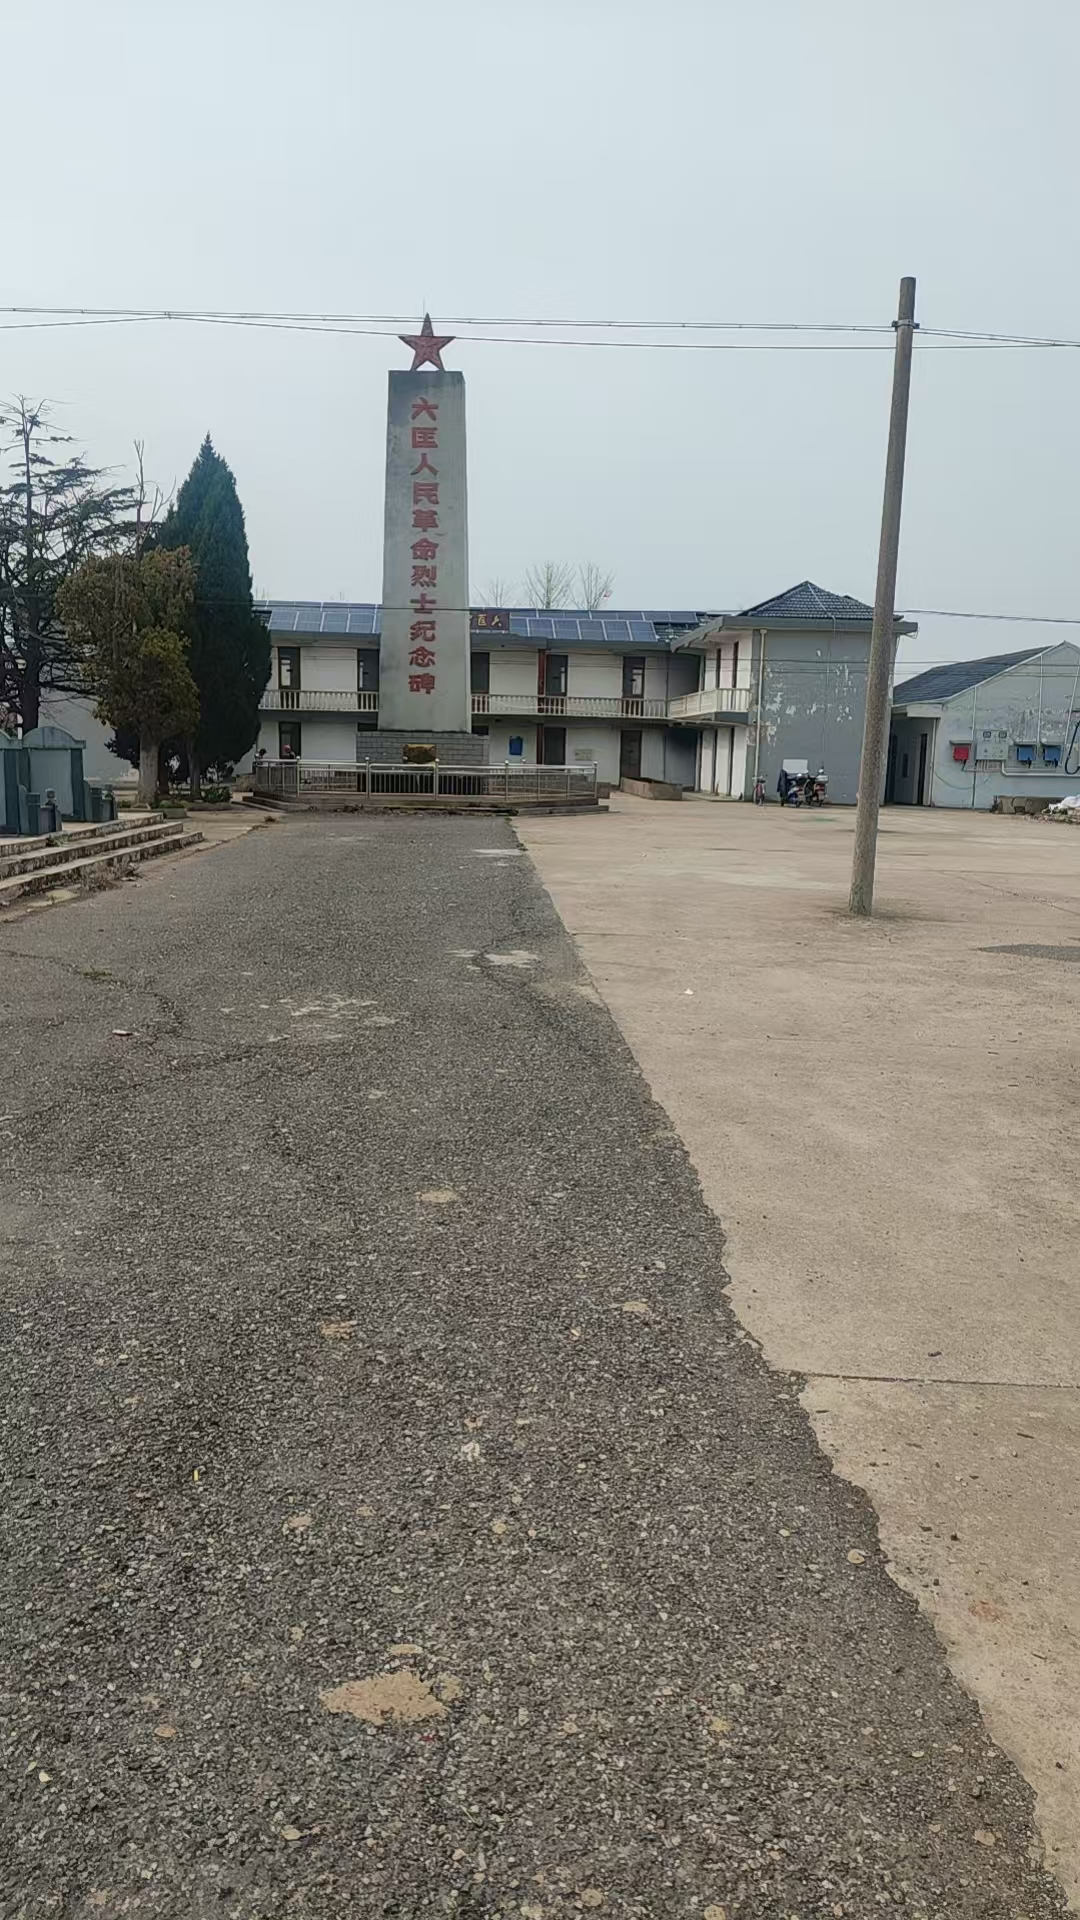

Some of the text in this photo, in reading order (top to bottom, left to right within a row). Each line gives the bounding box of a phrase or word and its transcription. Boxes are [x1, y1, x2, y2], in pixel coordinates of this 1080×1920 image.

[408, 397, 439, 695] 六匡人民革命烈士纪念碑
